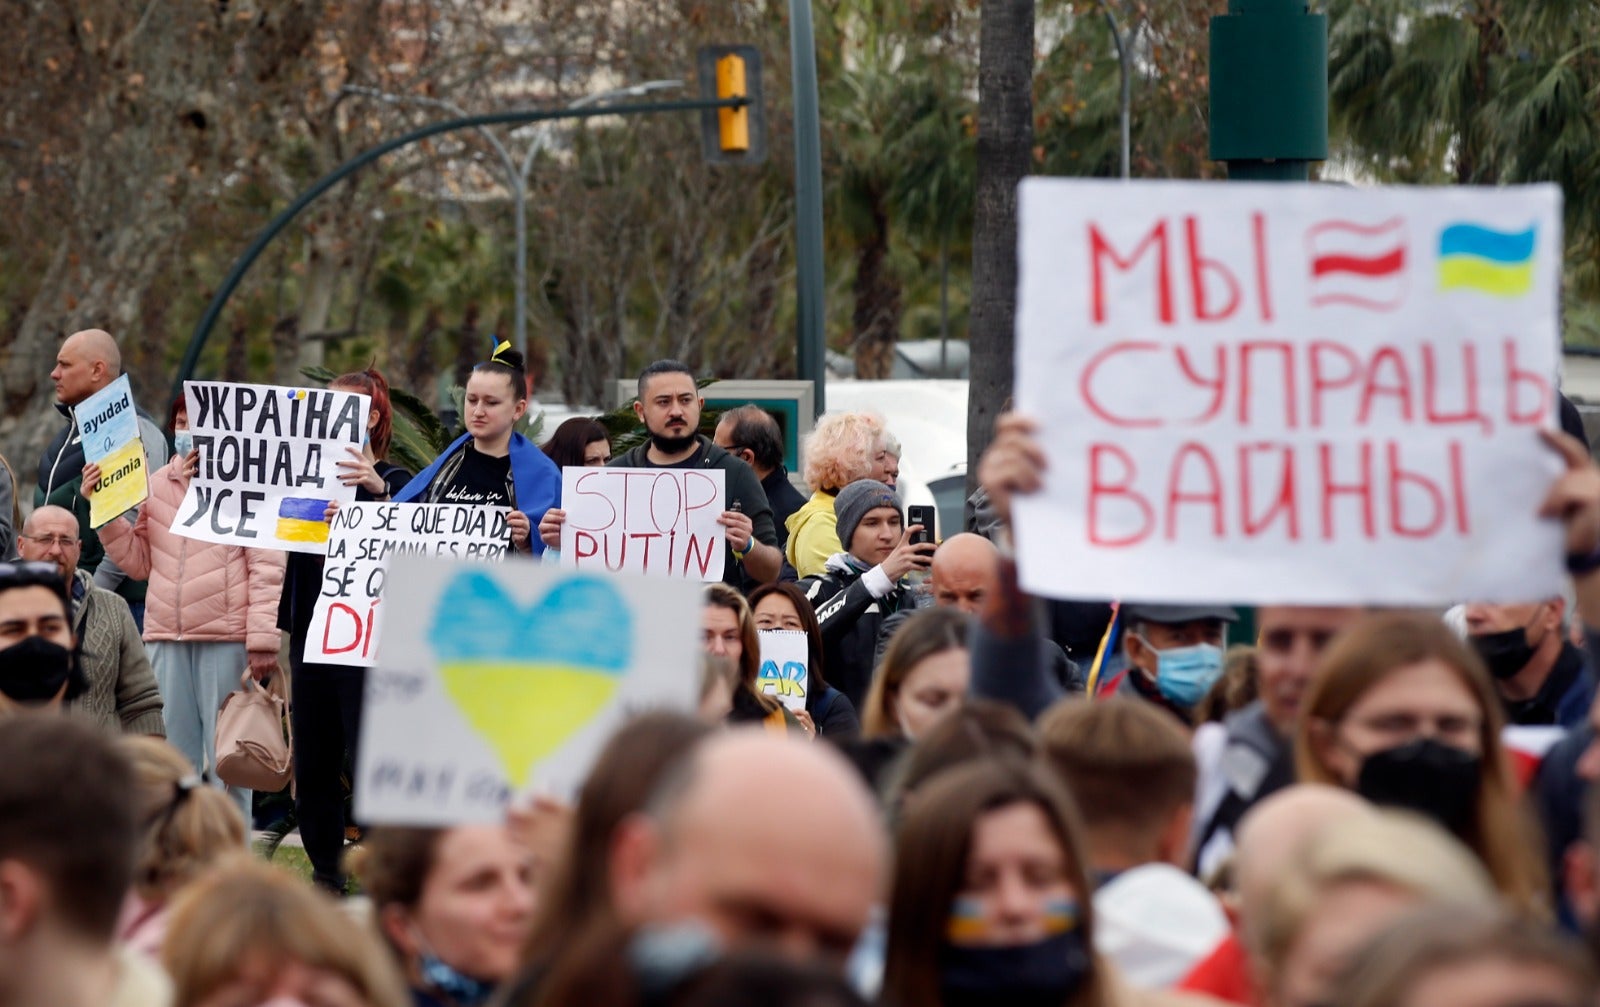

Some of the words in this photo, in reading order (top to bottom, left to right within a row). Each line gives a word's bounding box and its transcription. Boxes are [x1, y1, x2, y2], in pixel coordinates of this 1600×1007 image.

[1088, 210, 1273, 326] МЫ
[1079, 338, 1553, 435] СУПРАЦЬ
[83, 392, 130, 434] ayudad
[191, 385, 360, 444] УКРАЇНА
[192, 435, 325, 488] ПОНАД
[182, 486, 265, 538] УСЕ
[445, 484, 483, 502] believe
[486, 491, 503, 500] in
[569, 471, 718, 534] STOP
[1087, 440, 1470, 548] ВАЙНЫ
[334, 506, 363, 530] NO
[372, 503, 400, 531] SÉ
[411, 506, 450, 535] QUE
[452, 503, 486, 537] DÍA
[327, 538, 346, 559] LA
[355, 538, 428, 561] SEMANA
[575, 529, 716, 579] PUTIN
[322, 561, 357, 597] SÉ
[366, 567, 386, 598] Q
[322, 598, 382, 661] DÍ
[757, 659, 807, 698] AR
